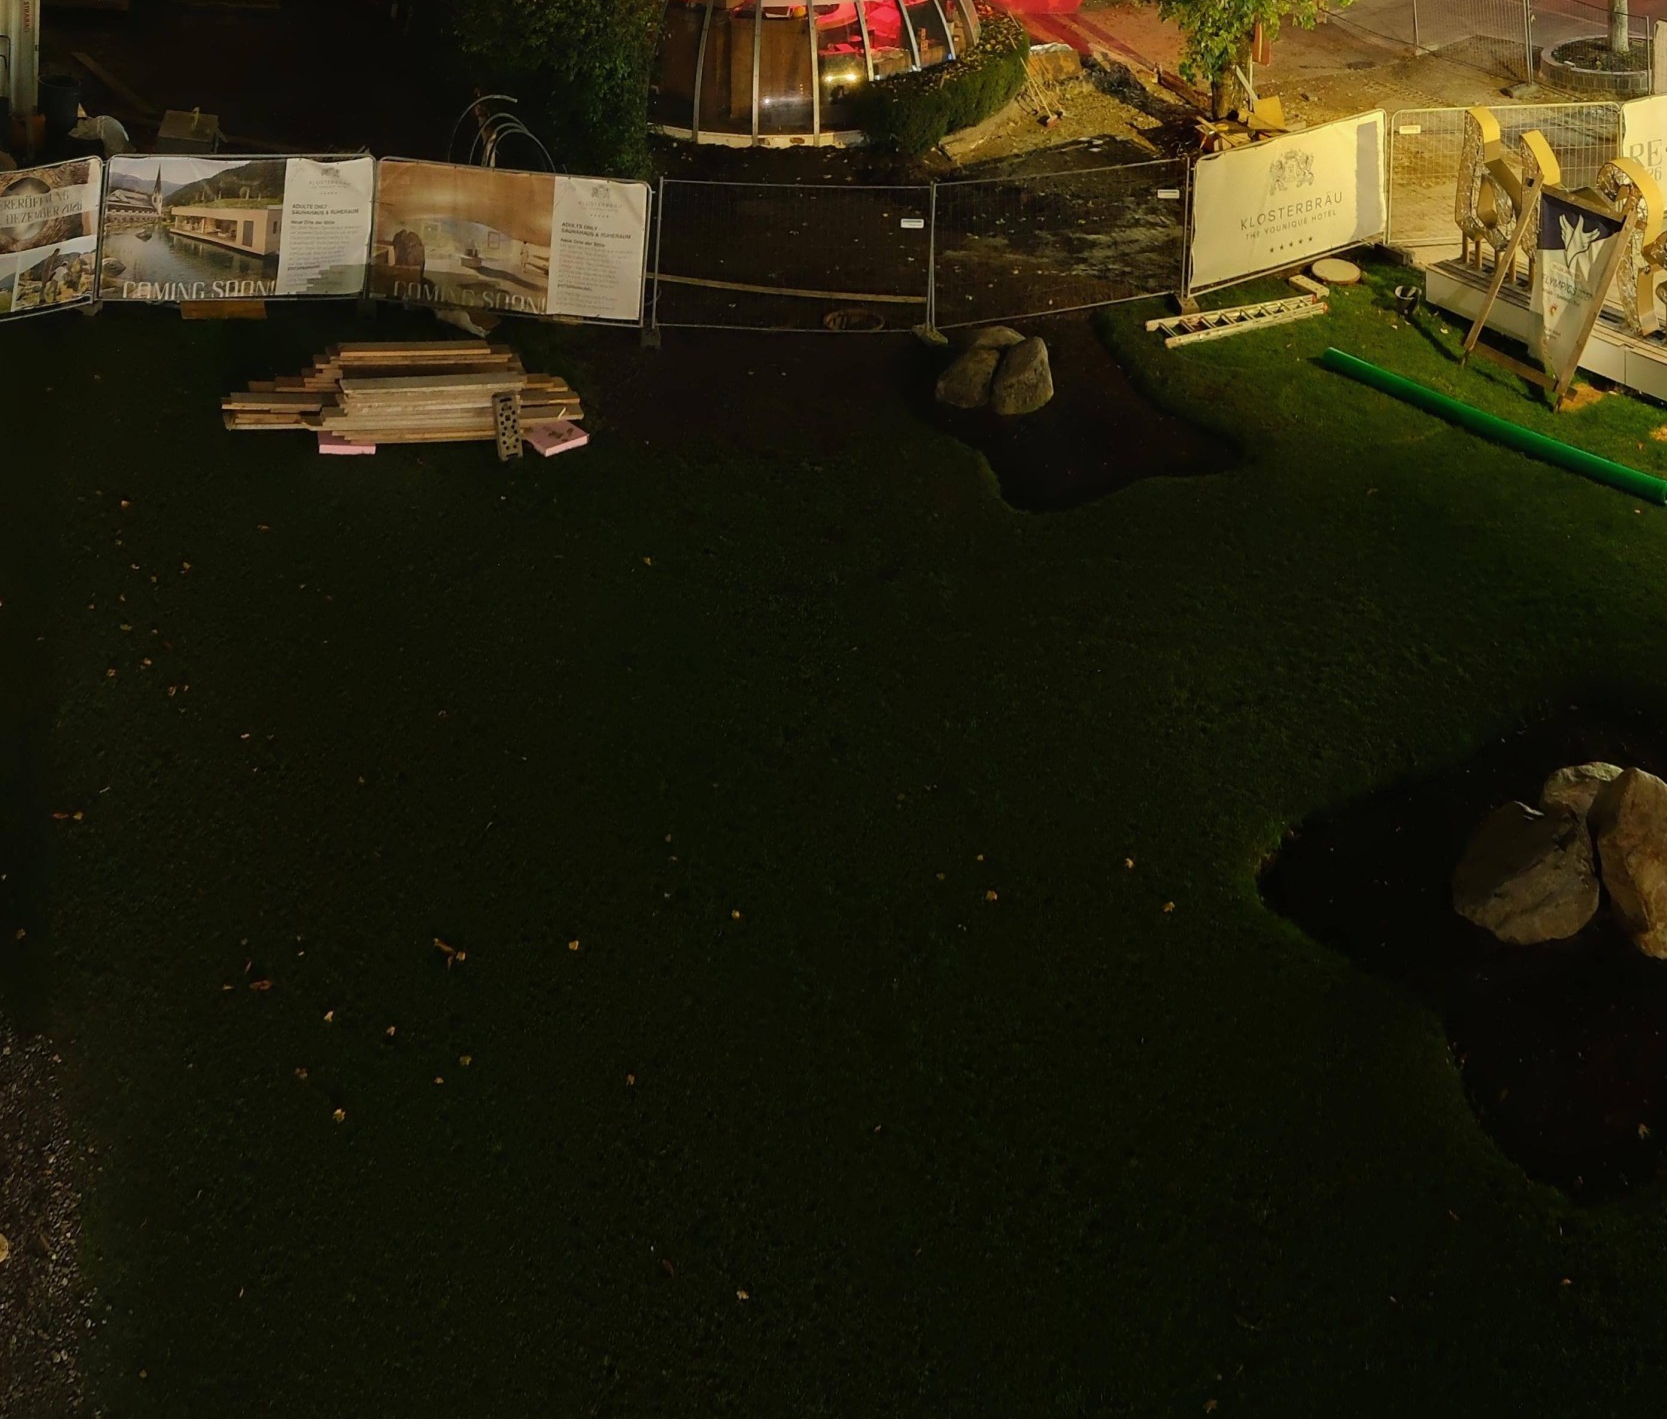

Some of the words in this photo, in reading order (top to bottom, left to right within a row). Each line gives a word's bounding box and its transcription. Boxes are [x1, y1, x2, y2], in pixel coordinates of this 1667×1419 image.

[1240, 190, 1343, 231] KLOSTERBRÄU
[1245, 231, 1260, 240] THE
[1264, 218, 1308, 235] YOUNIQUE
[1311, 209, 1337, 222] HOTEL
[122, 281, 206, 301] COMING
[211, 280, 276, 299] SOON!
